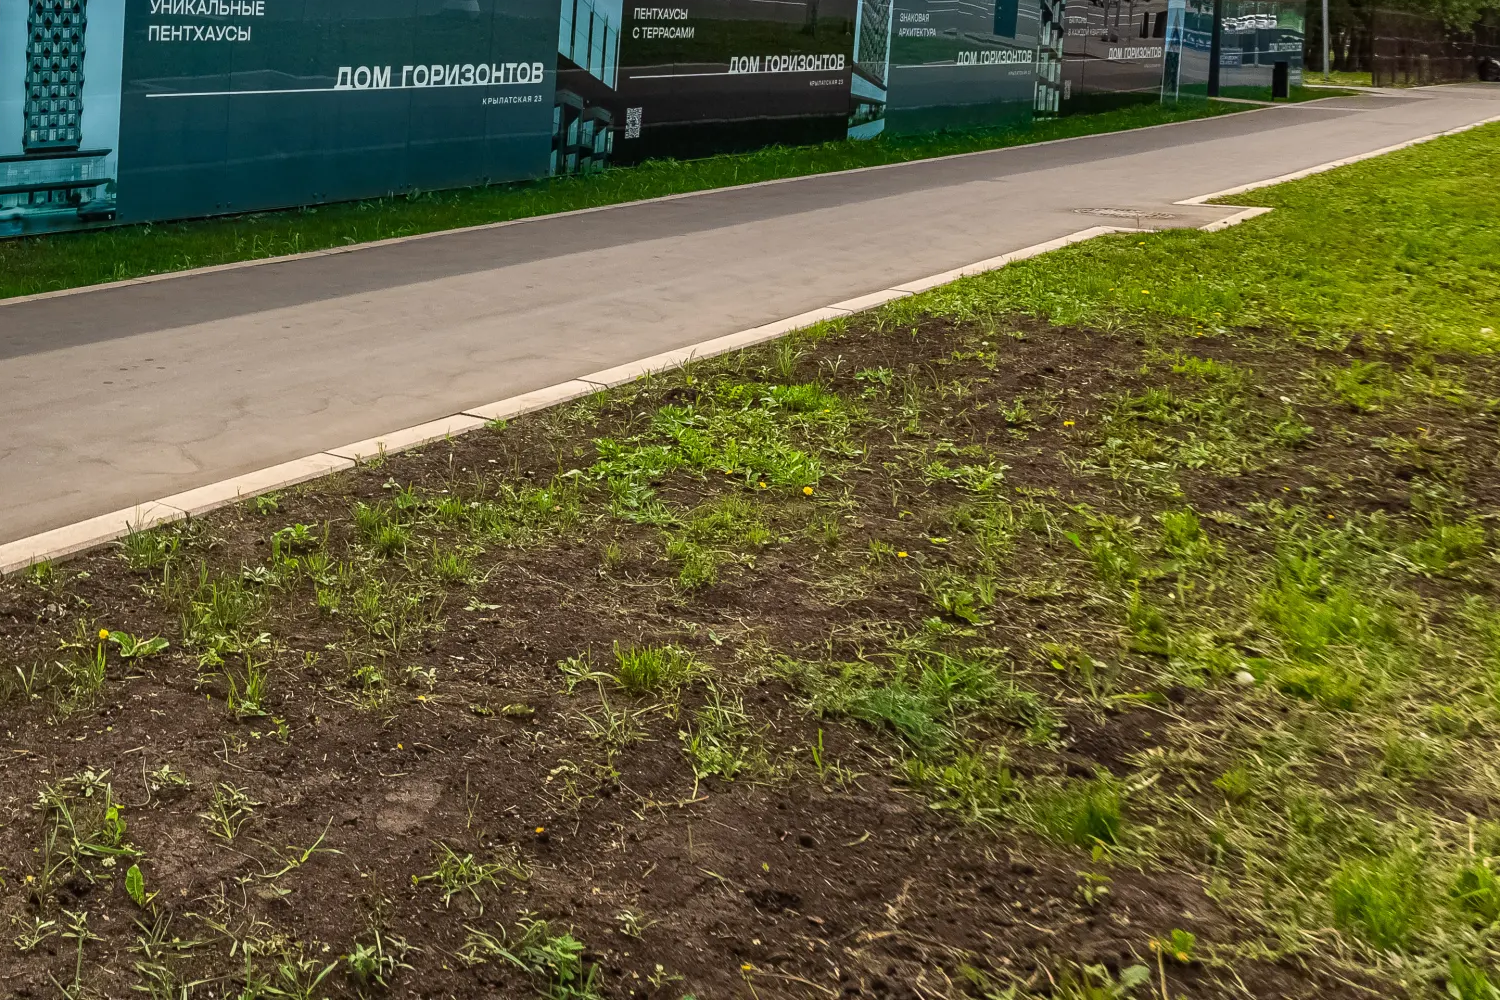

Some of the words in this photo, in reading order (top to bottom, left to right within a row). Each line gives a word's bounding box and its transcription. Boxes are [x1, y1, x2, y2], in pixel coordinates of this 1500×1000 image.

[633, 7, 689, 20] ПЕНТХАУСЫ
[899, 12, 930, 23] ЗНАКОВАЯ
[148, 25, 252, 42] ПЕНТХАУСЫ
[632, 27, 640, 39] С
[642, 26, 695, 39] ТЕРРАСАМИ
[898, 27, 937, 37] АРХИТЕКТУРА
[956, 51, 978, 66] ДОМ
[979, 49, 1033, 65] ГОРИЗОНТОВ
[1107, 47, 1122, 60] ДОМ
[1123, 46, 1162, 60] ГОРИЗОНТОВ
[728, 56, 760, 74] ДОМ
[764, 54, 845, 72] ГОРИЗОНТОВ
[333, 65, 392, 90] ДОМ
[401, 62, 544, 88] ГОРИЗОНТОВ
[482, 95, 532, 106] КРЫЛАТСКАЯ
[533, 94, 542, 104] 23
